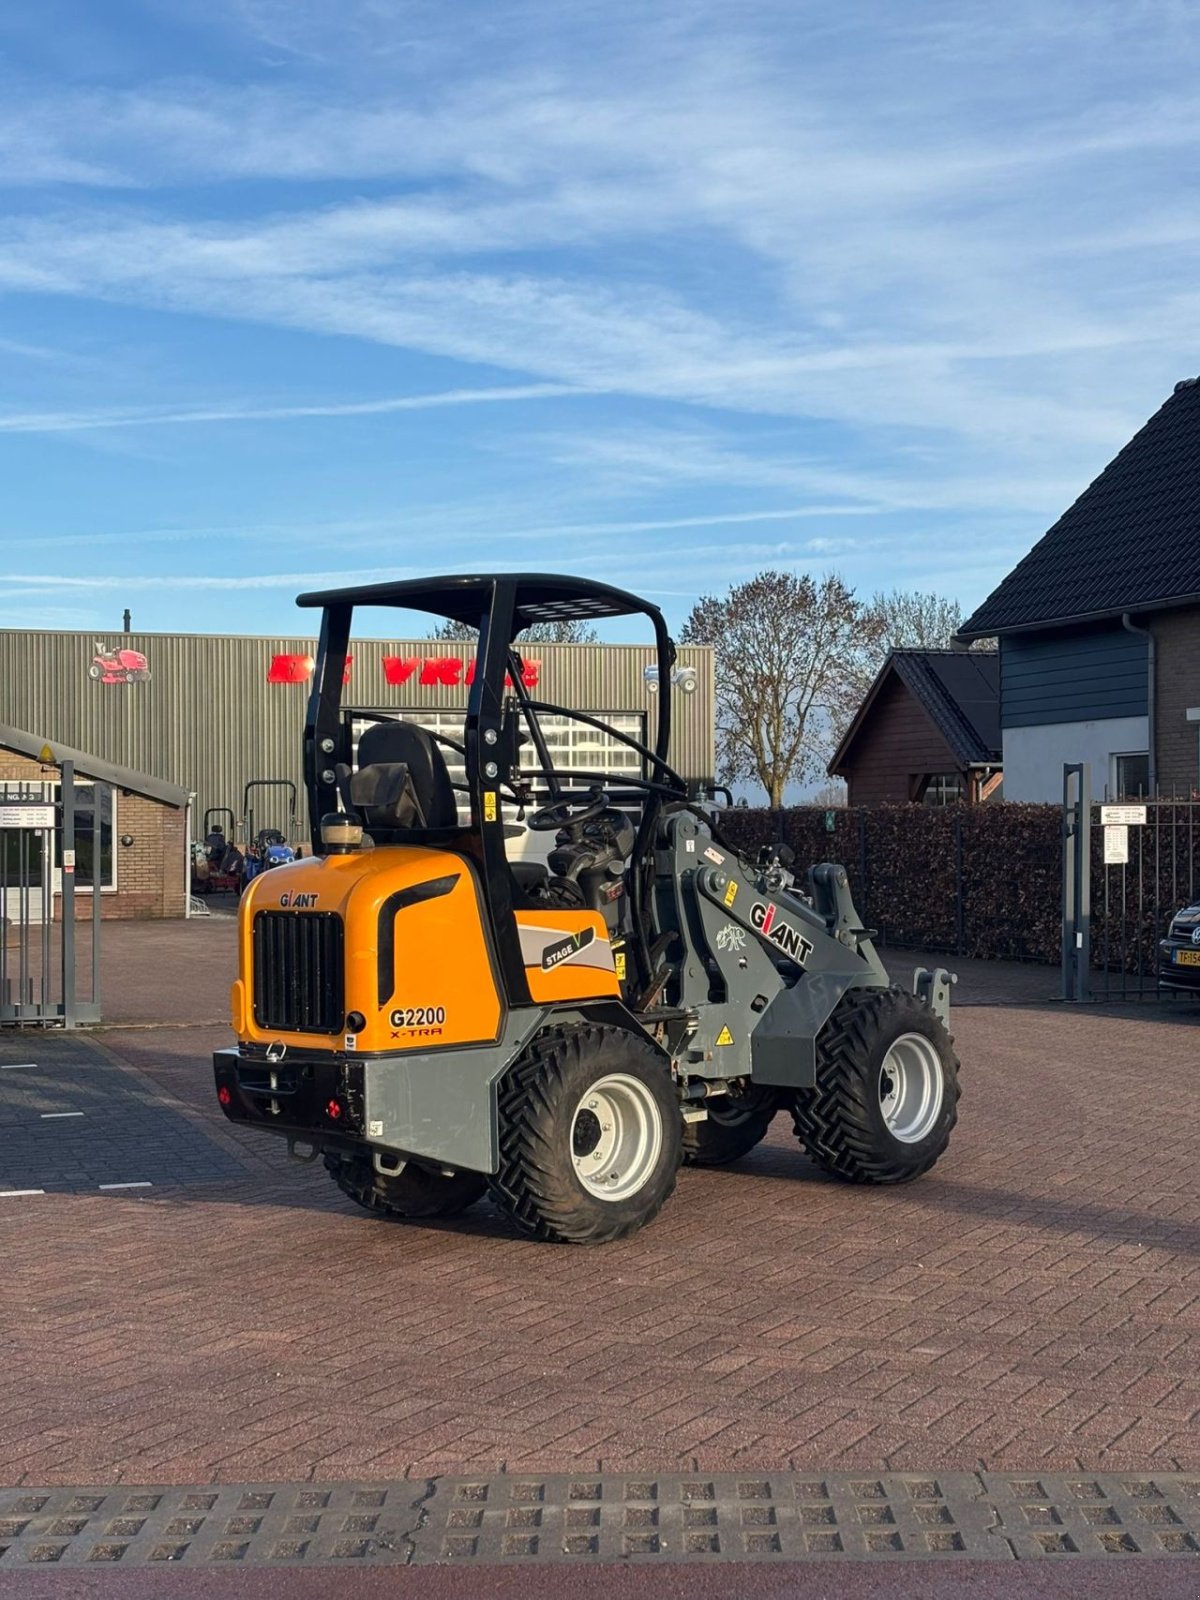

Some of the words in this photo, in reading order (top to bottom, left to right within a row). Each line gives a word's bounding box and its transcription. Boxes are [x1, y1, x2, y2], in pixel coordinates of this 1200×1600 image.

[546, 944, 573, 966] STAGE
[390, 1006, 446, 1028] G2200
[390, 1027, 443, 1039] X-TRA
